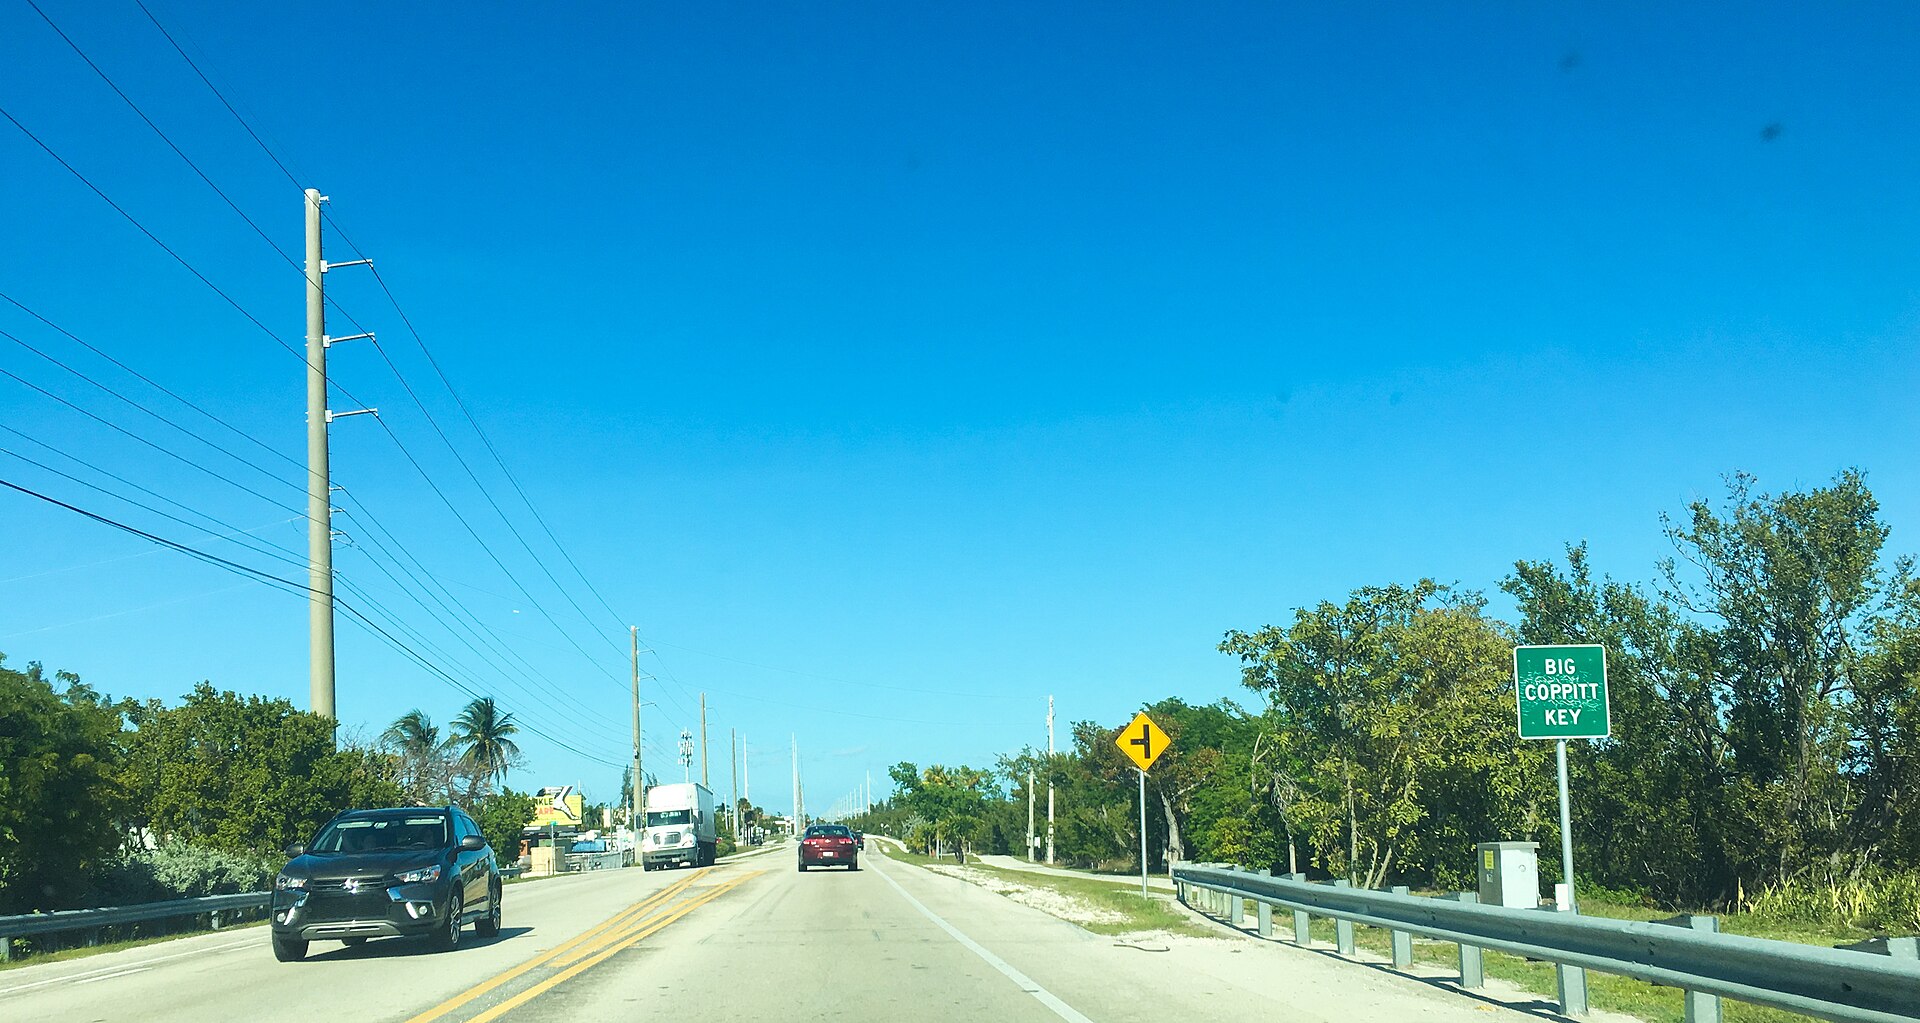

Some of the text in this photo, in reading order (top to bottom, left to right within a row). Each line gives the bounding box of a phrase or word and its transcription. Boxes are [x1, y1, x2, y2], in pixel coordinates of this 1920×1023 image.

[1545, 658, 1576, 675] BIG
[1525, 682, 1599, 701] COPPITT
[1545, 708, 1582, 725] KEY
